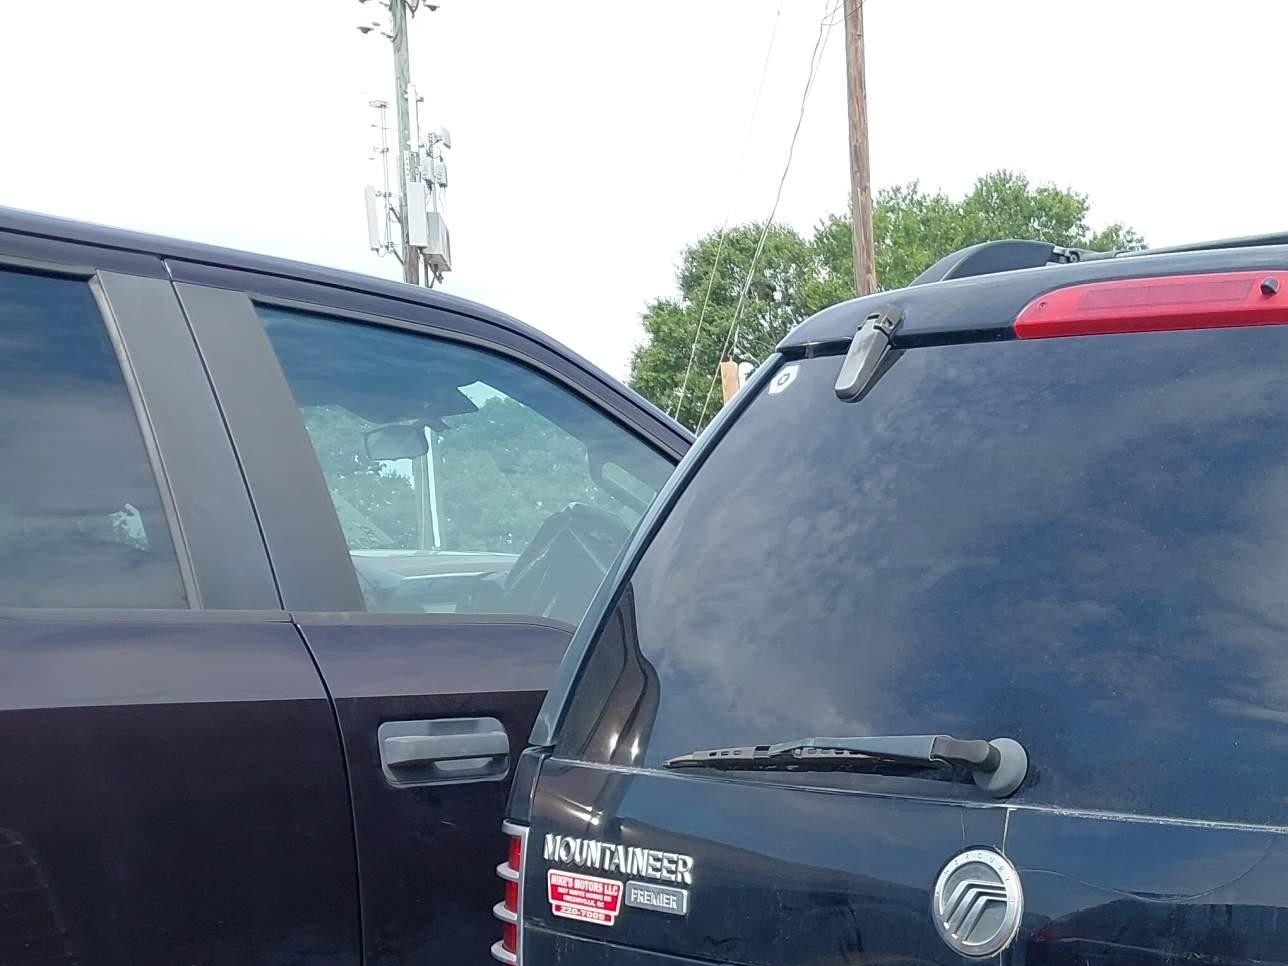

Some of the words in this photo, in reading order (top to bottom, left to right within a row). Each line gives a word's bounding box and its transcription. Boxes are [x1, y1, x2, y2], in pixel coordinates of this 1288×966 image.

[543, 834, 695, 885] MOUNTAINEER
[943, 852, 1010, 881] MERCURY
[574, 878, 603, 893] MOTORS
[604, 884, 618, 897] LLC
[630, 888, 677, 909] PREMIER
